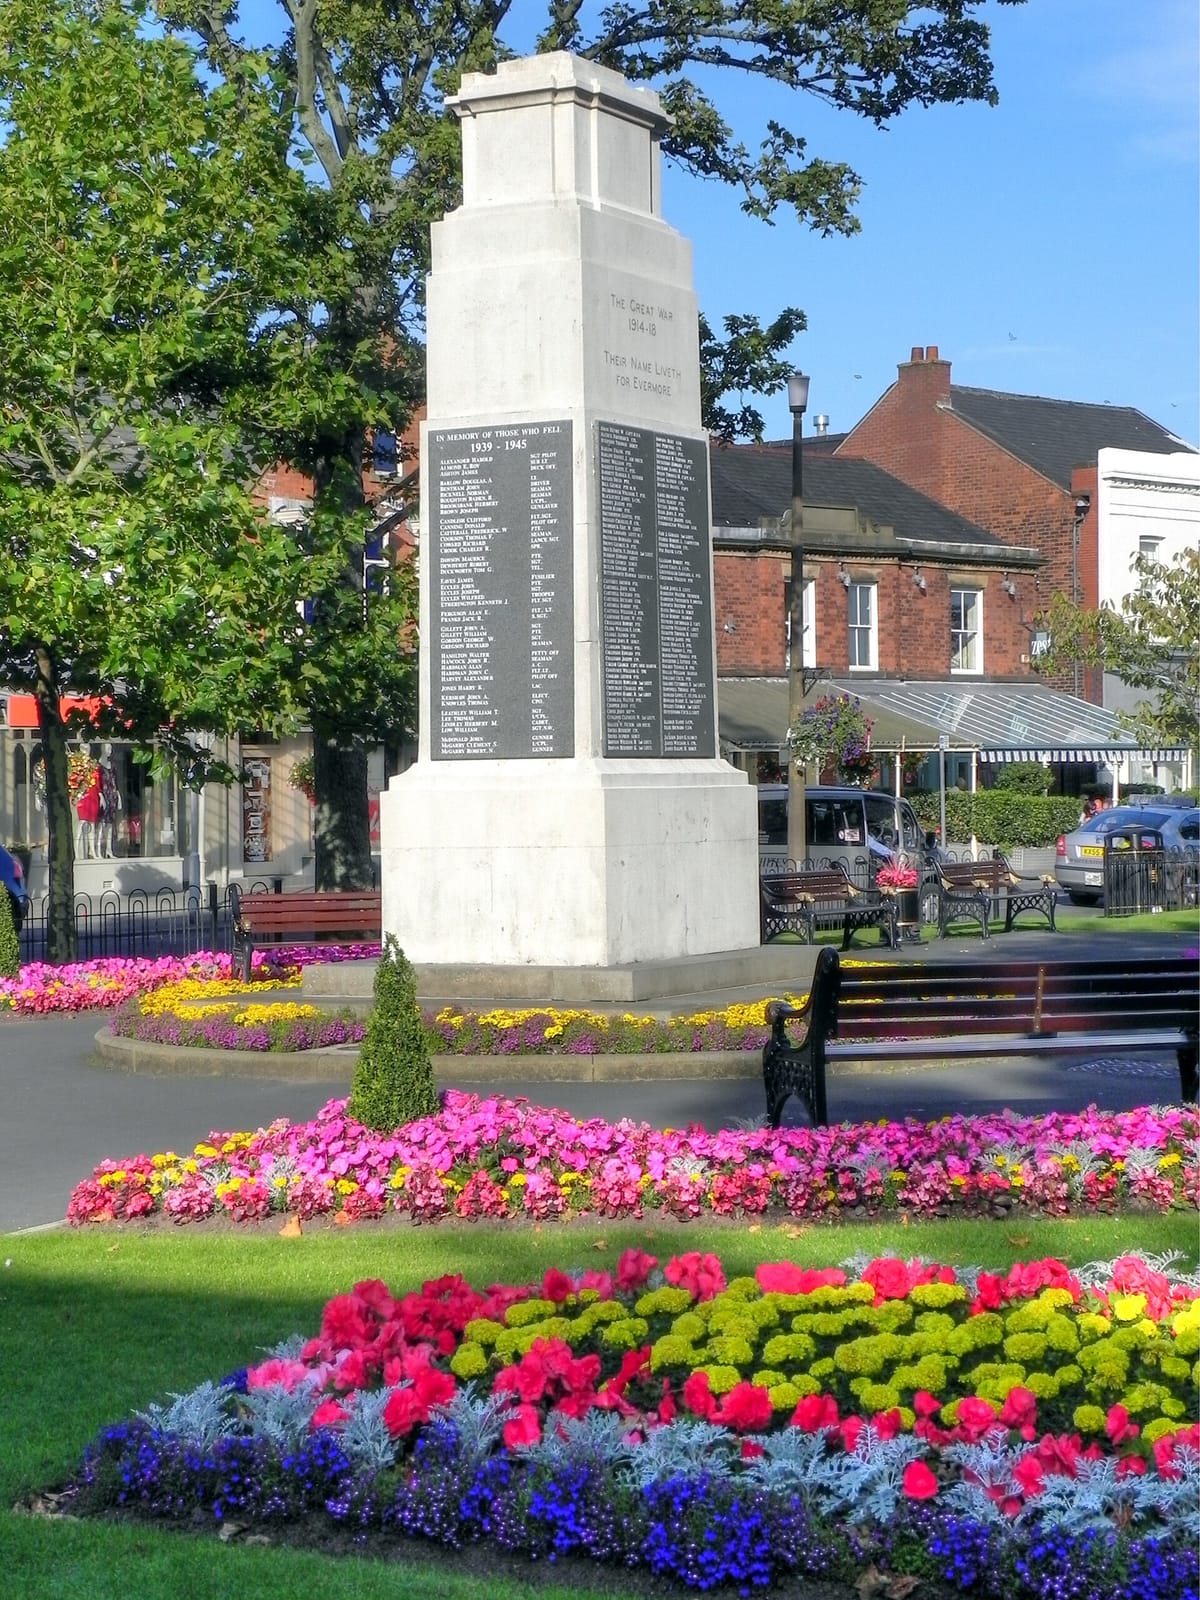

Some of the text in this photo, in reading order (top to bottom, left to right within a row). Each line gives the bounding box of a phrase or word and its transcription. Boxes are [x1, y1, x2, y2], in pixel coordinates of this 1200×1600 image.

[611, 294, 673, 320] THE GREAT WAR
[629, 318, 657, 336] 1914-18
[604, 350, 681, 379] THEIR NAME LIVETH
[616, 375, 672, 396] FOR EVERMORE
[447, 433, 480, 441] MEMORY
[522, 427, 540, 436] WHO
[471, 442, 493, 453] 1939
[504, 439, 527, 450] 1945
